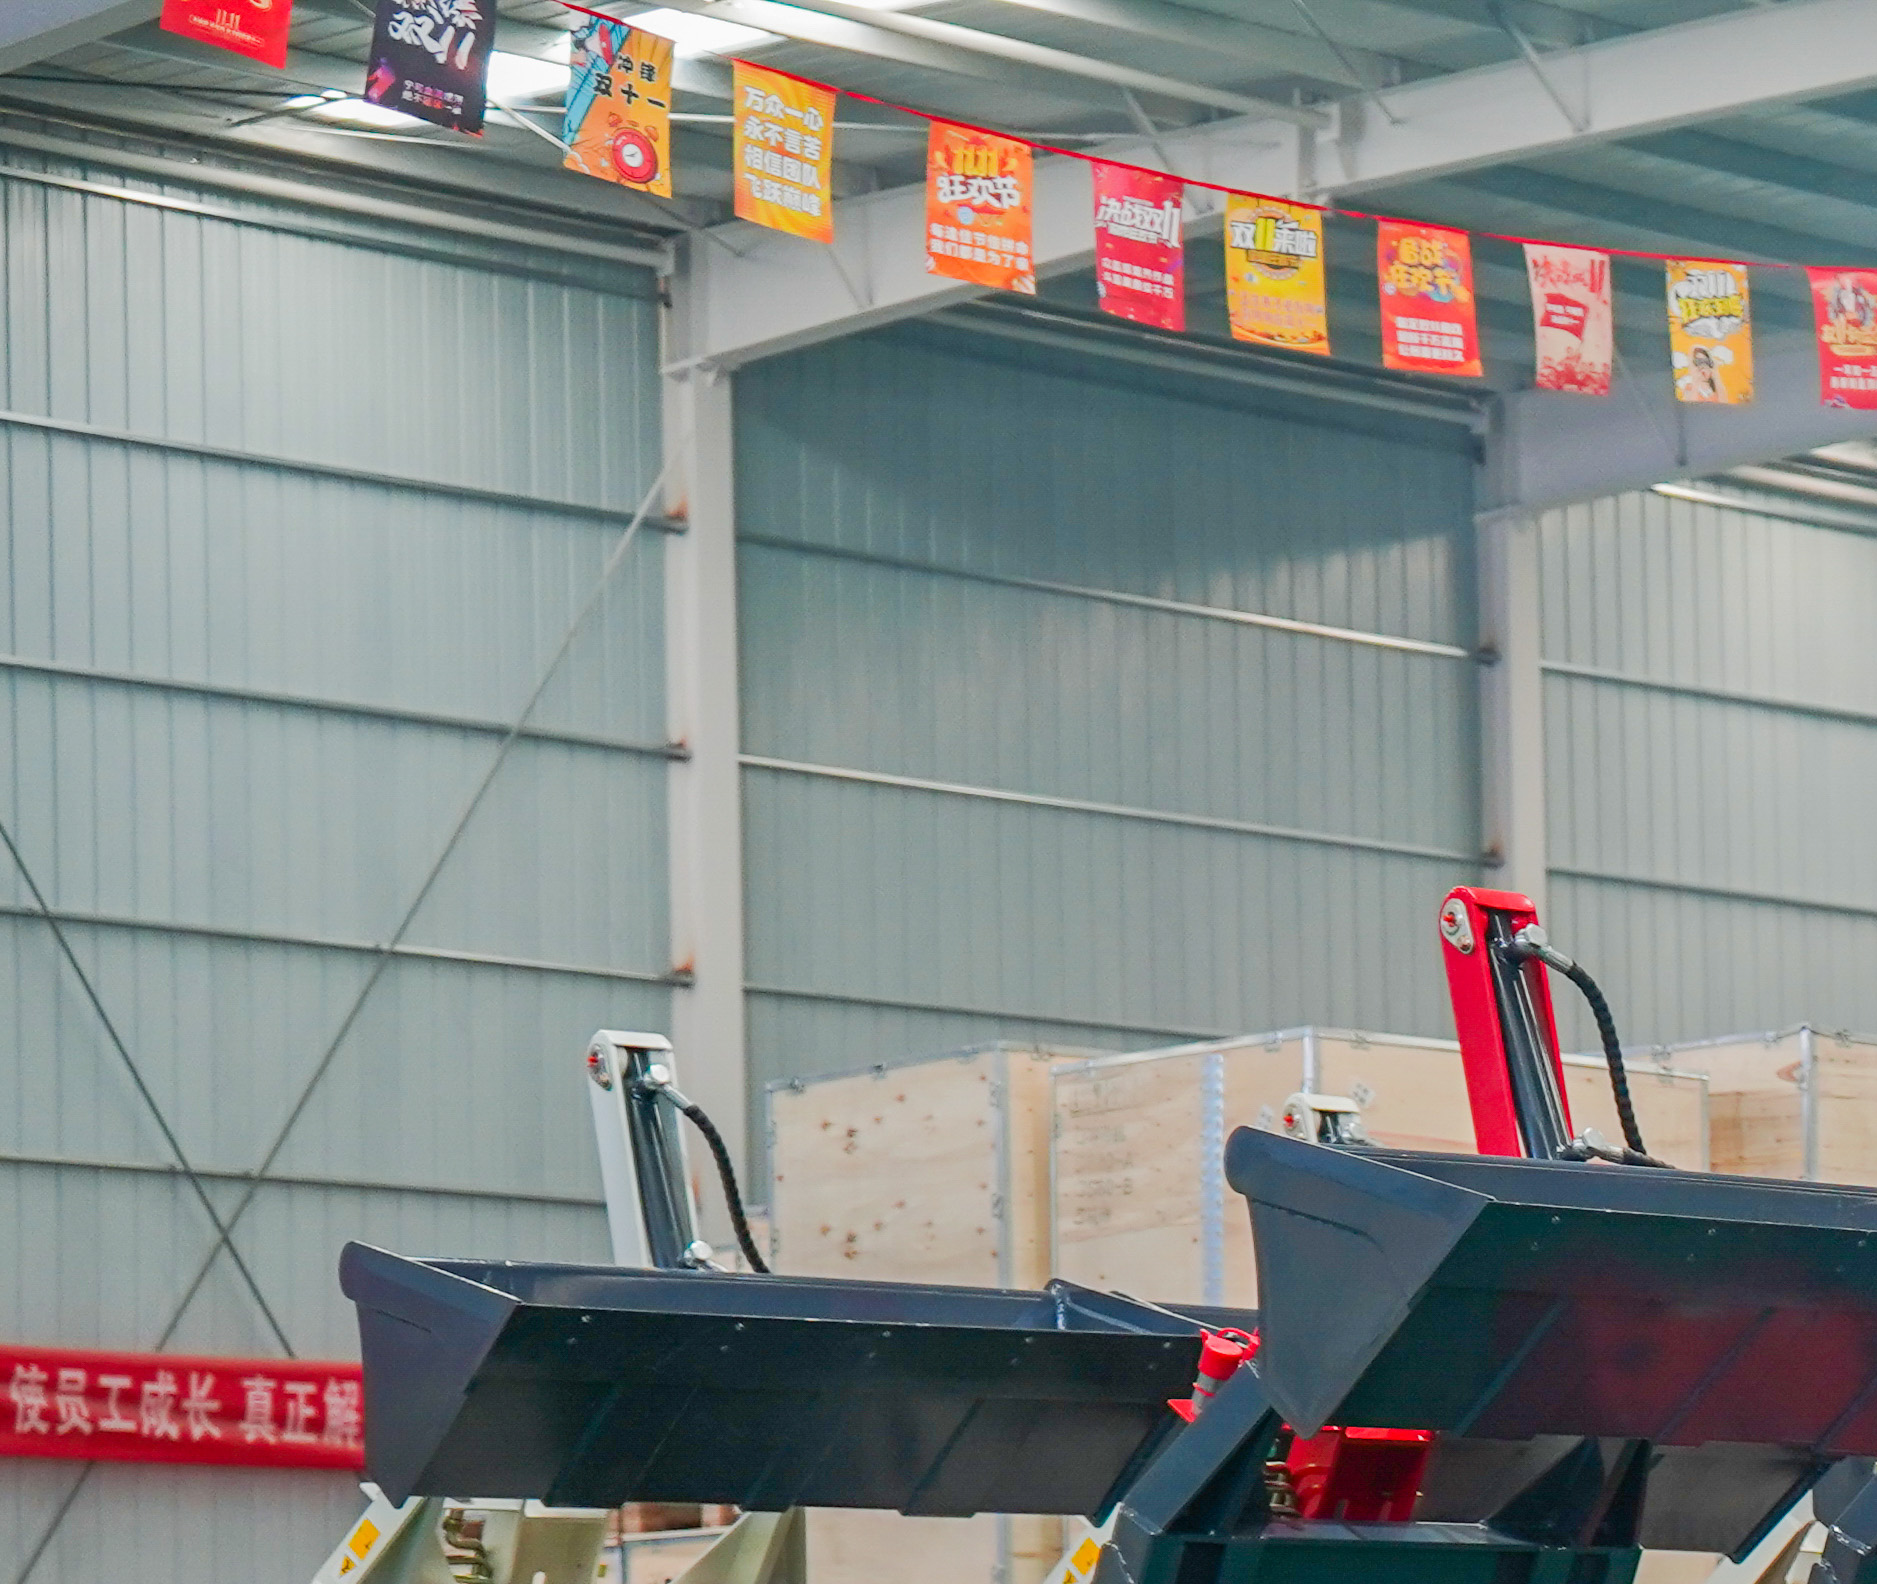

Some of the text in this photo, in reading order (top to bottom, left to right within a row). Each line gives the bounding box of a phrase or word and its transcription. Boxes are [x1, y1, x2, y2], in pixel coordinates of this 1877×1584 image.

[593, 70, 666, 108] 双十一
[744, 85, 824, 132] 万众一心
[743, 144, 822, 190] 相信团队
[936, 173, 1020, 209] 狂欢节
